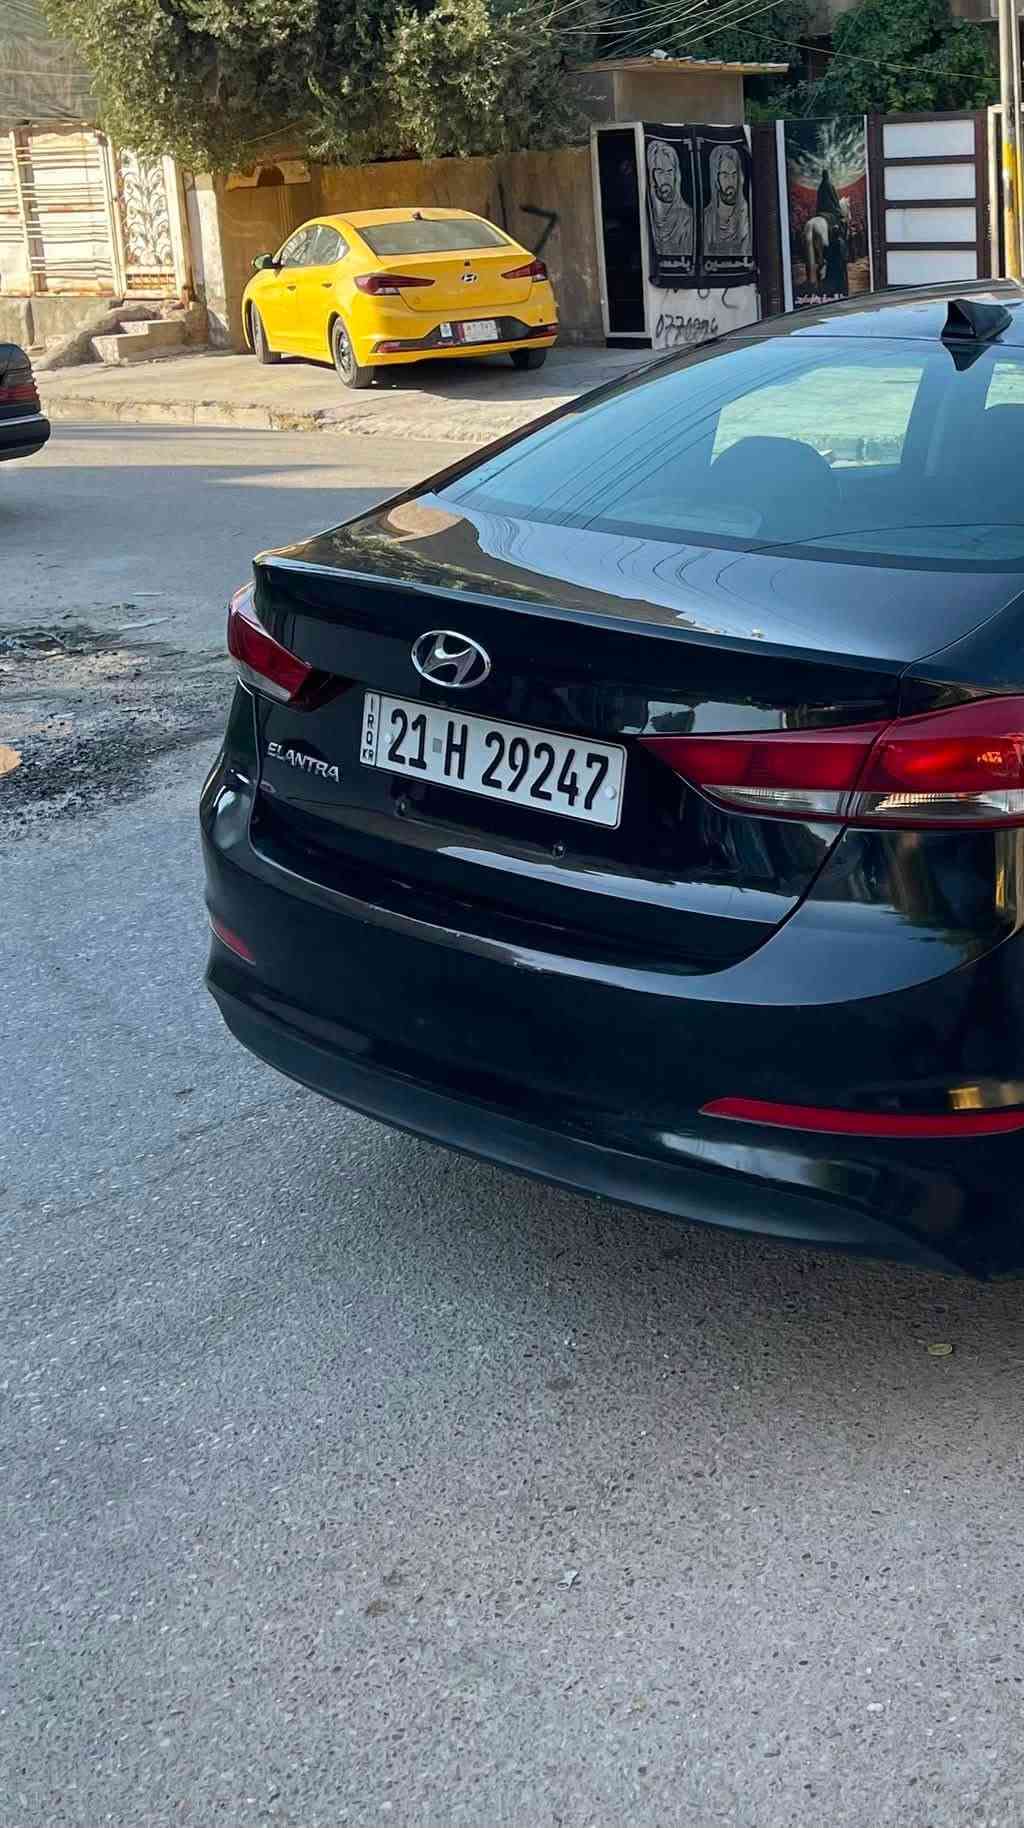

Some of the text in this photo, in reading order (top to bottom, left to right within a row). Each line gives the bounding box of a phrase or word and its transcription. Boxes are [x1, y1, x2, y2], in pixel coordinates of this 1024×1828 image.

[267, 741, 340, 783] ELANTRA
[387, 708, 609, 811] 21 H 29247
